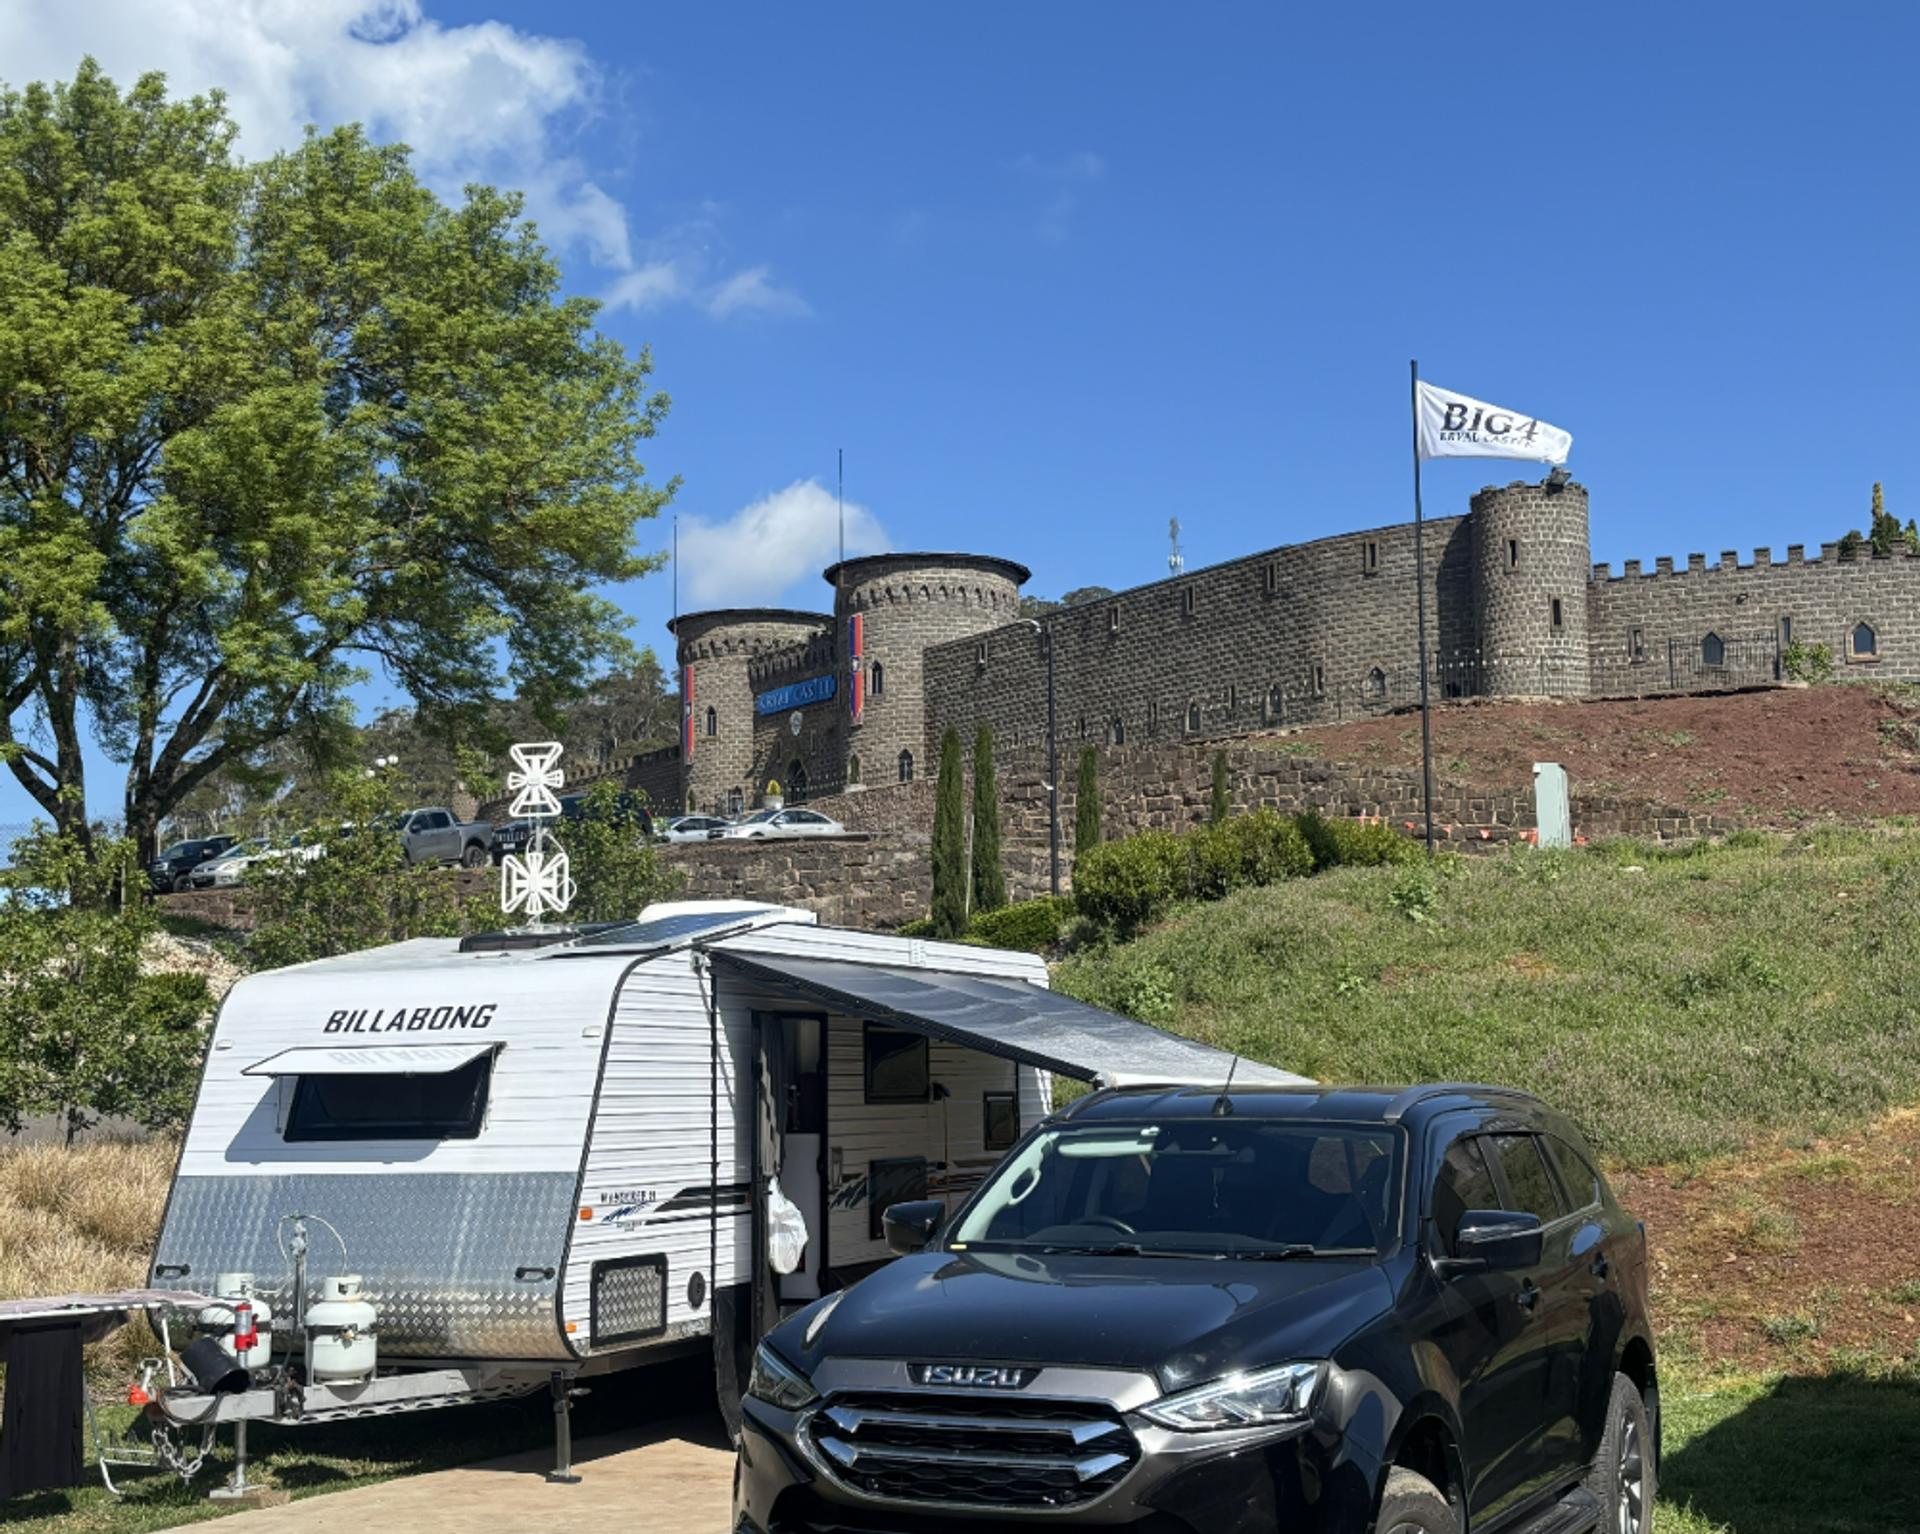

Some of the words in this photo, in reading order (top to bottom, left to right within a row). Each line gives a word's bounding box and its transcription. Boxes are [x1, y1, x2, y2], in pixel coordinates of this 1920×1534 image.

[1440, 402, 1539, 441] BIG4
[323, 1004, 498, 1033] BILLABONG
[922, 1365, 1023, 1386] ISUZU
